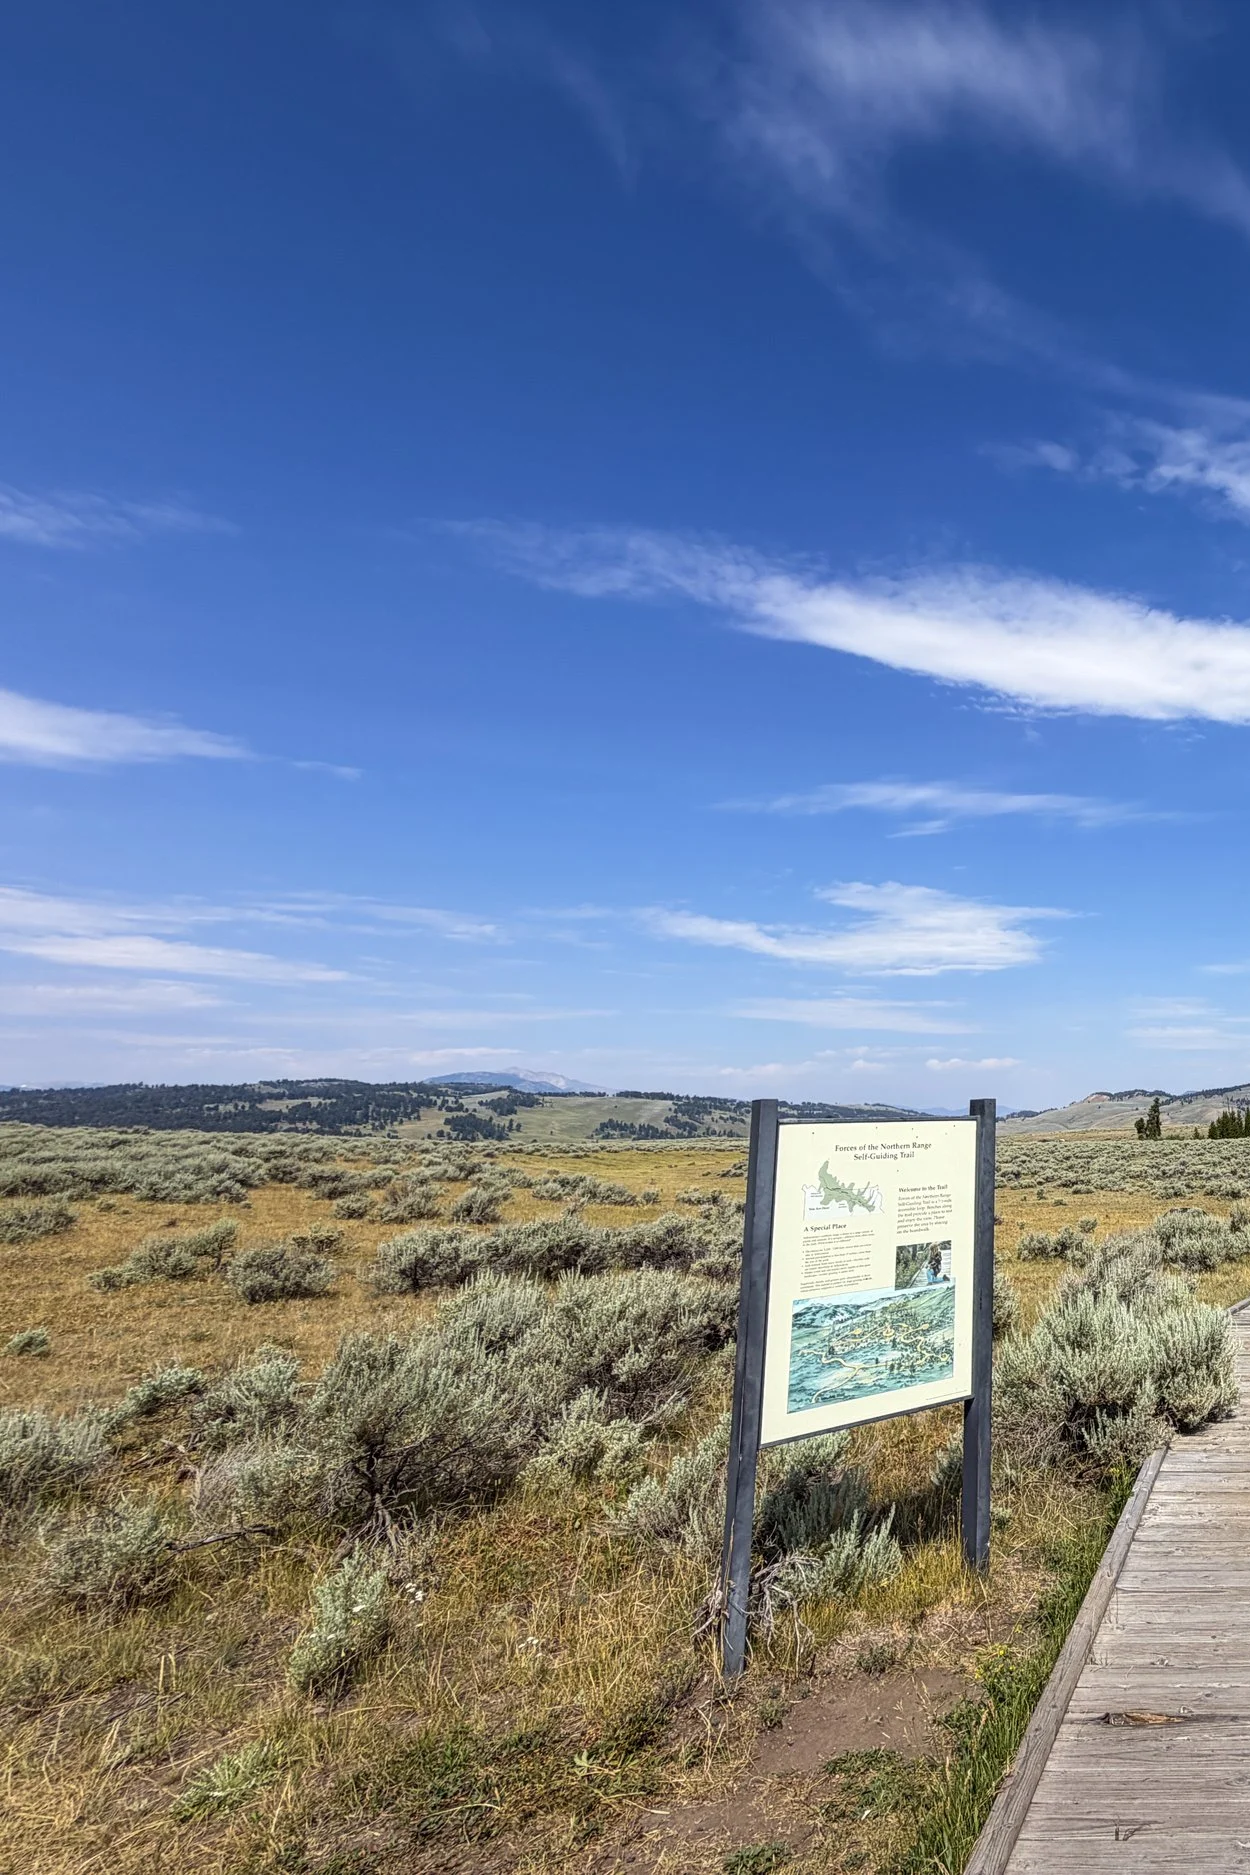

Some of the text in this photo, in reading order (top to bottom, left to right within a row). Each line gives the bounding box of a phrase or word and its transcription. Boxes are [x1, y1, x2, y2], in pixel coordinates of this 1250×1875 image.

[912, 1142, 932, 1150] Range
[854, 1152, 898, 1160] Self-Guiding
[810, 1224, 831, 1232] Special
